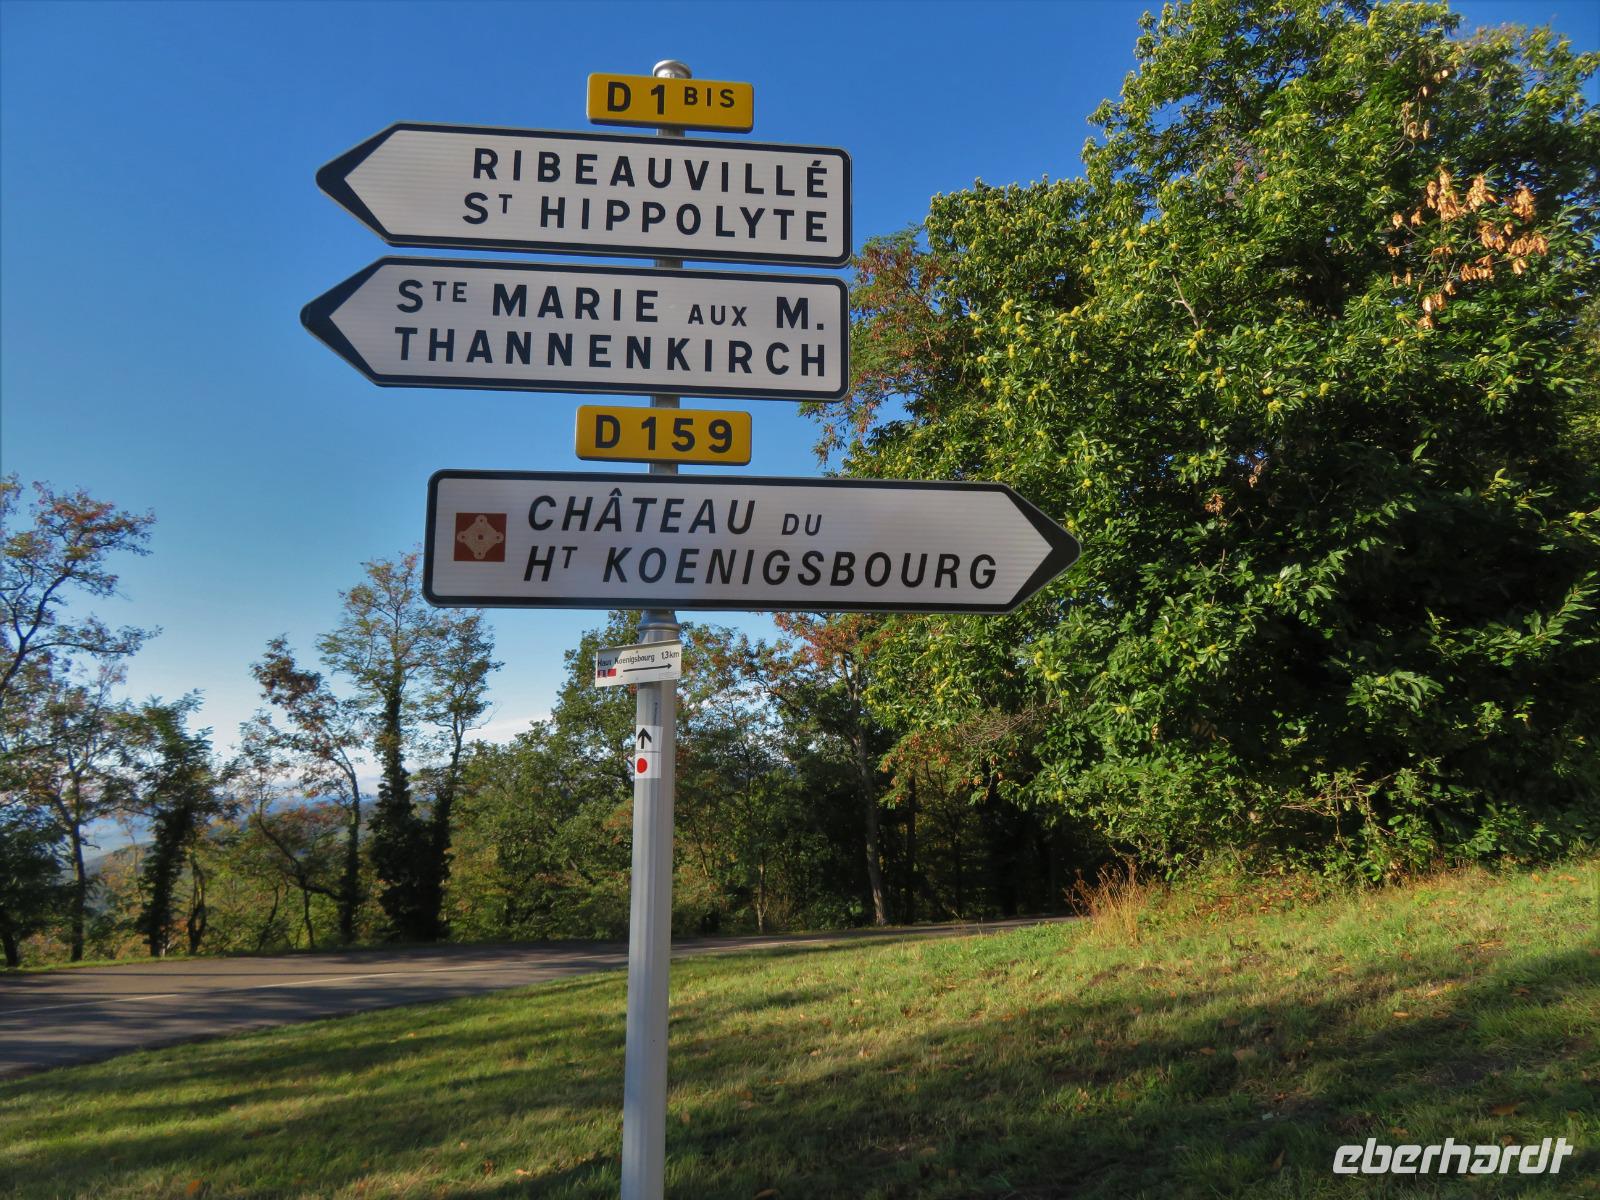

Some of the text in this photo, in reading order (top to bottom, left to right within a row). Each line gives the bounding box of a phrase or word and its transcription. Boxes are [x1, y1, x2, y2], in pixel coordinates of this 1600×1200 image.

[607, 82, 735, 115] D 1 BIS
[473, 148, 828, 198] RIBEAUVILLÉ
[462, 192, 828, 242] ST HIPPOLYTE
[397, 279, 824, 330] STE MARIE AUX M.
[395, 326, 825, 377] THANNENKIRCH
[596, 414, 732, 453] D 159
[528, 488, 822, 536] CHÂTEAU DU
[603, 547, 997, 589] KOENIGSBOURG
[615, 654, 655, 665] Koenigsbourg
